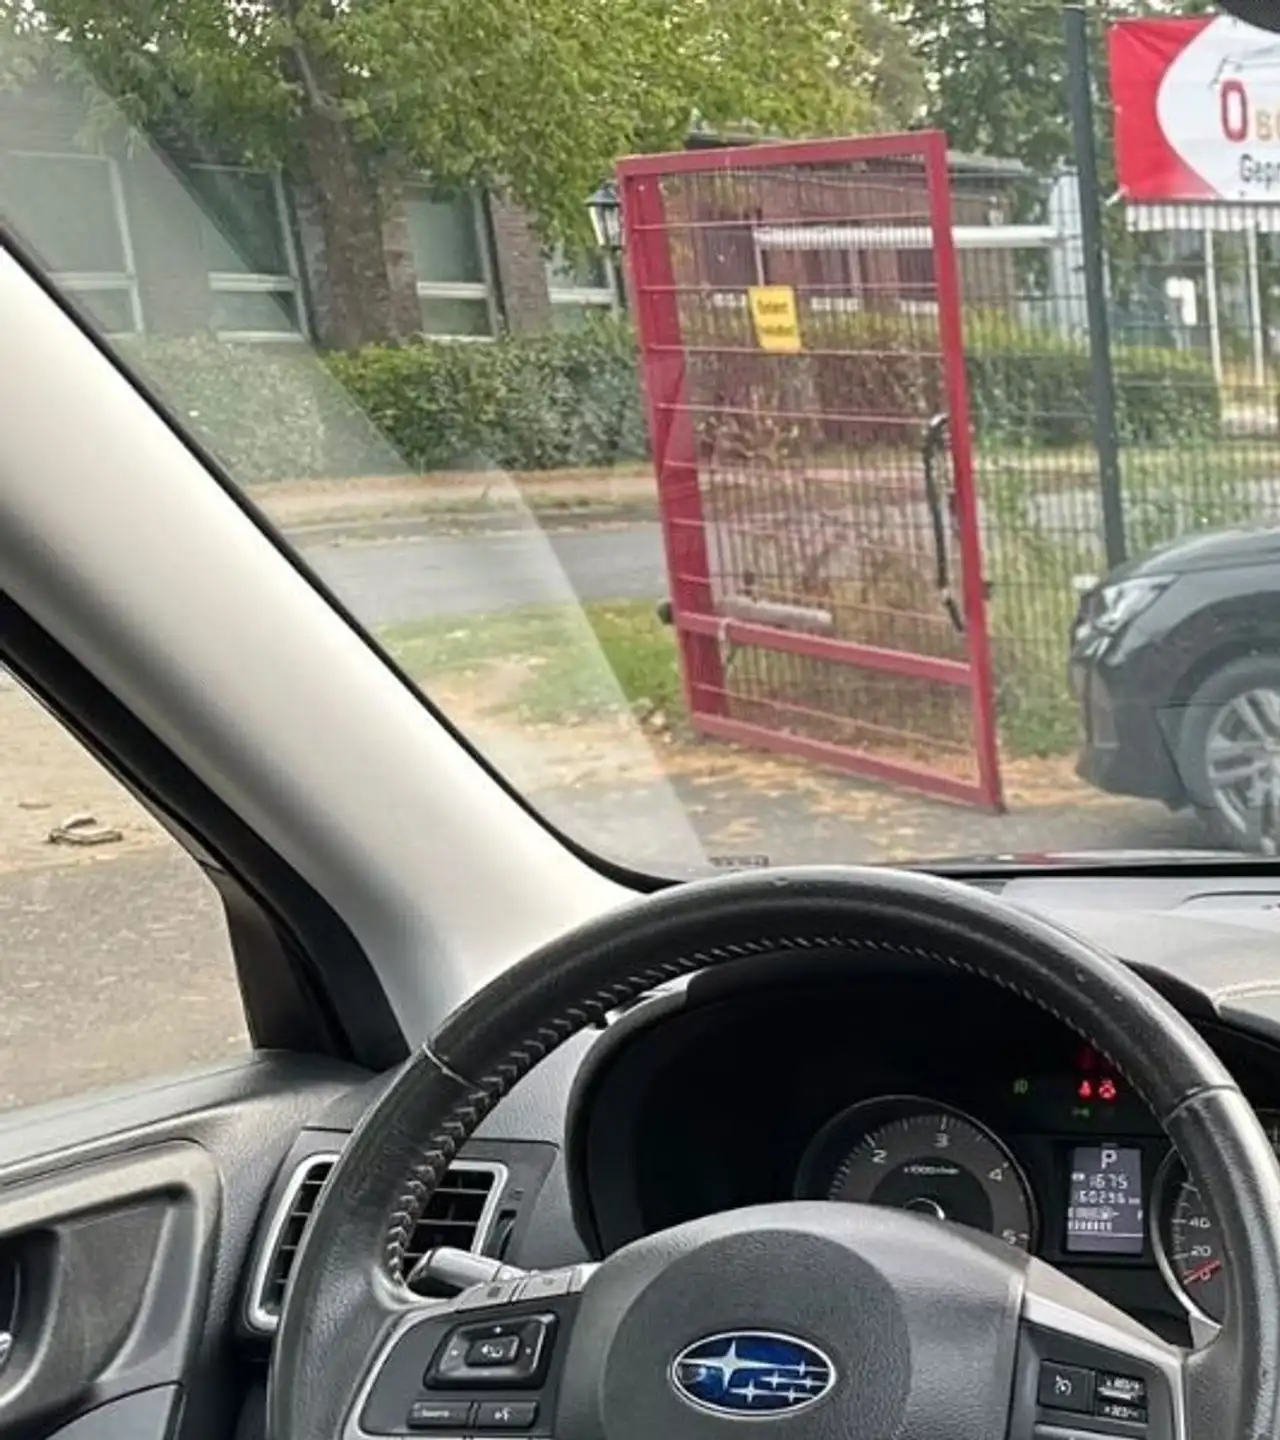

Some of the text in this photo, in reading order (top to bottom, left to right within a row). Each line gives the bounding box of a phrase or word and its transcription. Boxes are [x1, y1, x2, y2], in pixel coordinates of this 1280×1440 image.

[935, 1133, 949, 1148] 3
[872, 1150, 887, 1164] 2
[1101, 1149, 1118, 1169] P
[988, 1168, 1003, 1181] 4
[1188, 1216, 1211, 1229] 40
[1191, 1245, 1211, 1257] 20
